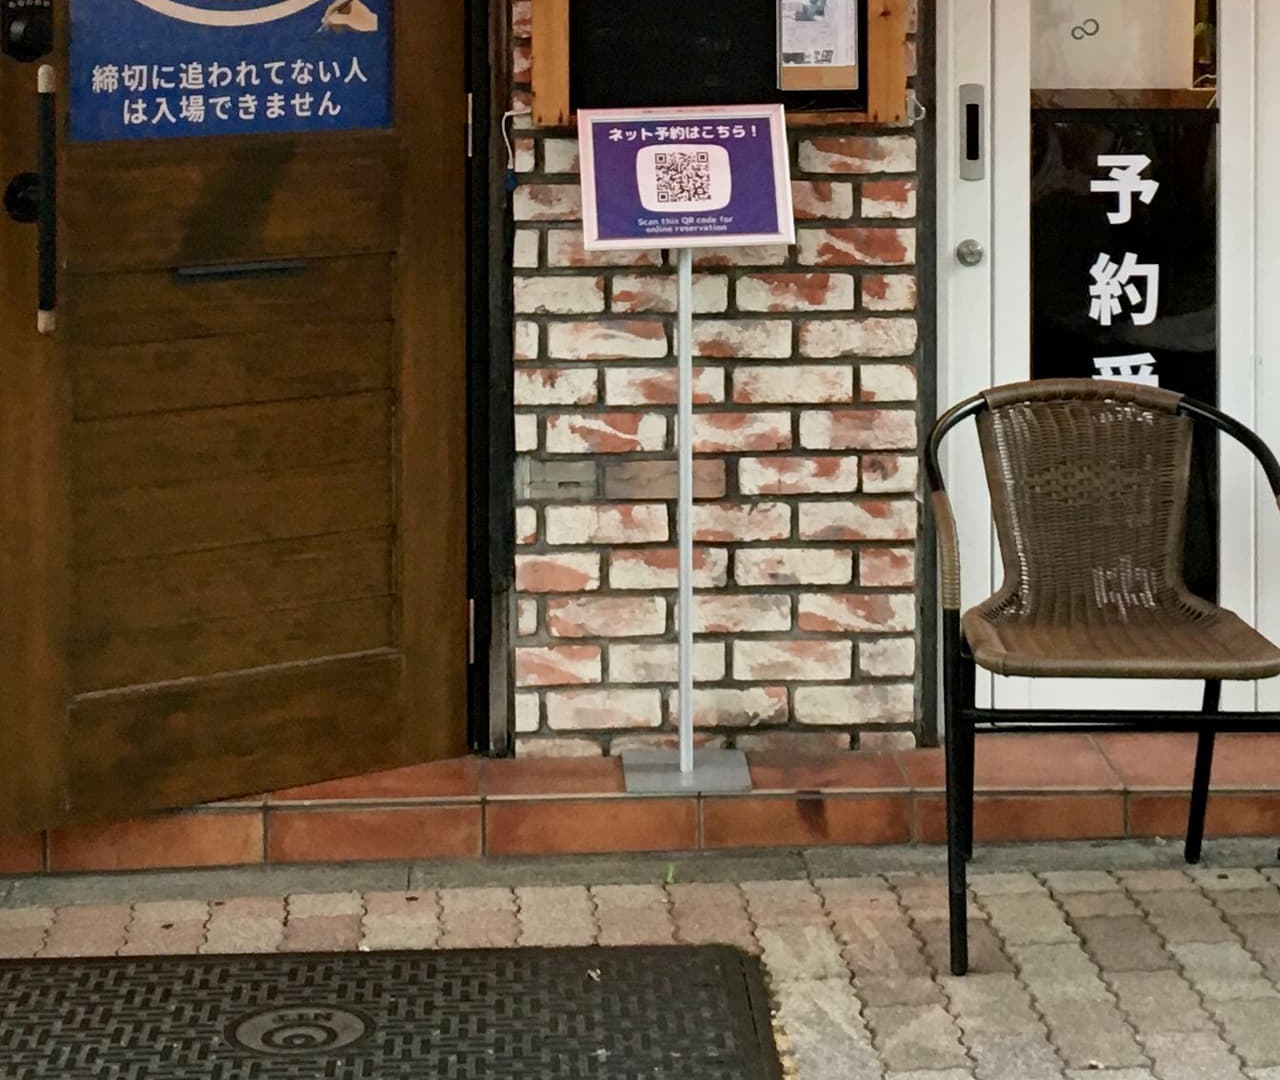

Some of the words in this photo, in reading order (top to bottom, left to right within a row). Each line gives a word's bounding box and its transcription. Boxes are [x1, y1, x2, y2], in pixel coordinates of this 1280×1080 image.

[91, 56, 369, 95] 締切に追われてない人
[123, 91, 342, 126] は入場できません
[638, 218, 658, 227] Scan
[661, 217, 679, 226] this
[681, 216, 694, 225] QR
[696, 216, 717, 225] code
[719, 215, 733, 224] for
[645, 225, 673, 234] online
[675, 223, 727, 233] reservation
